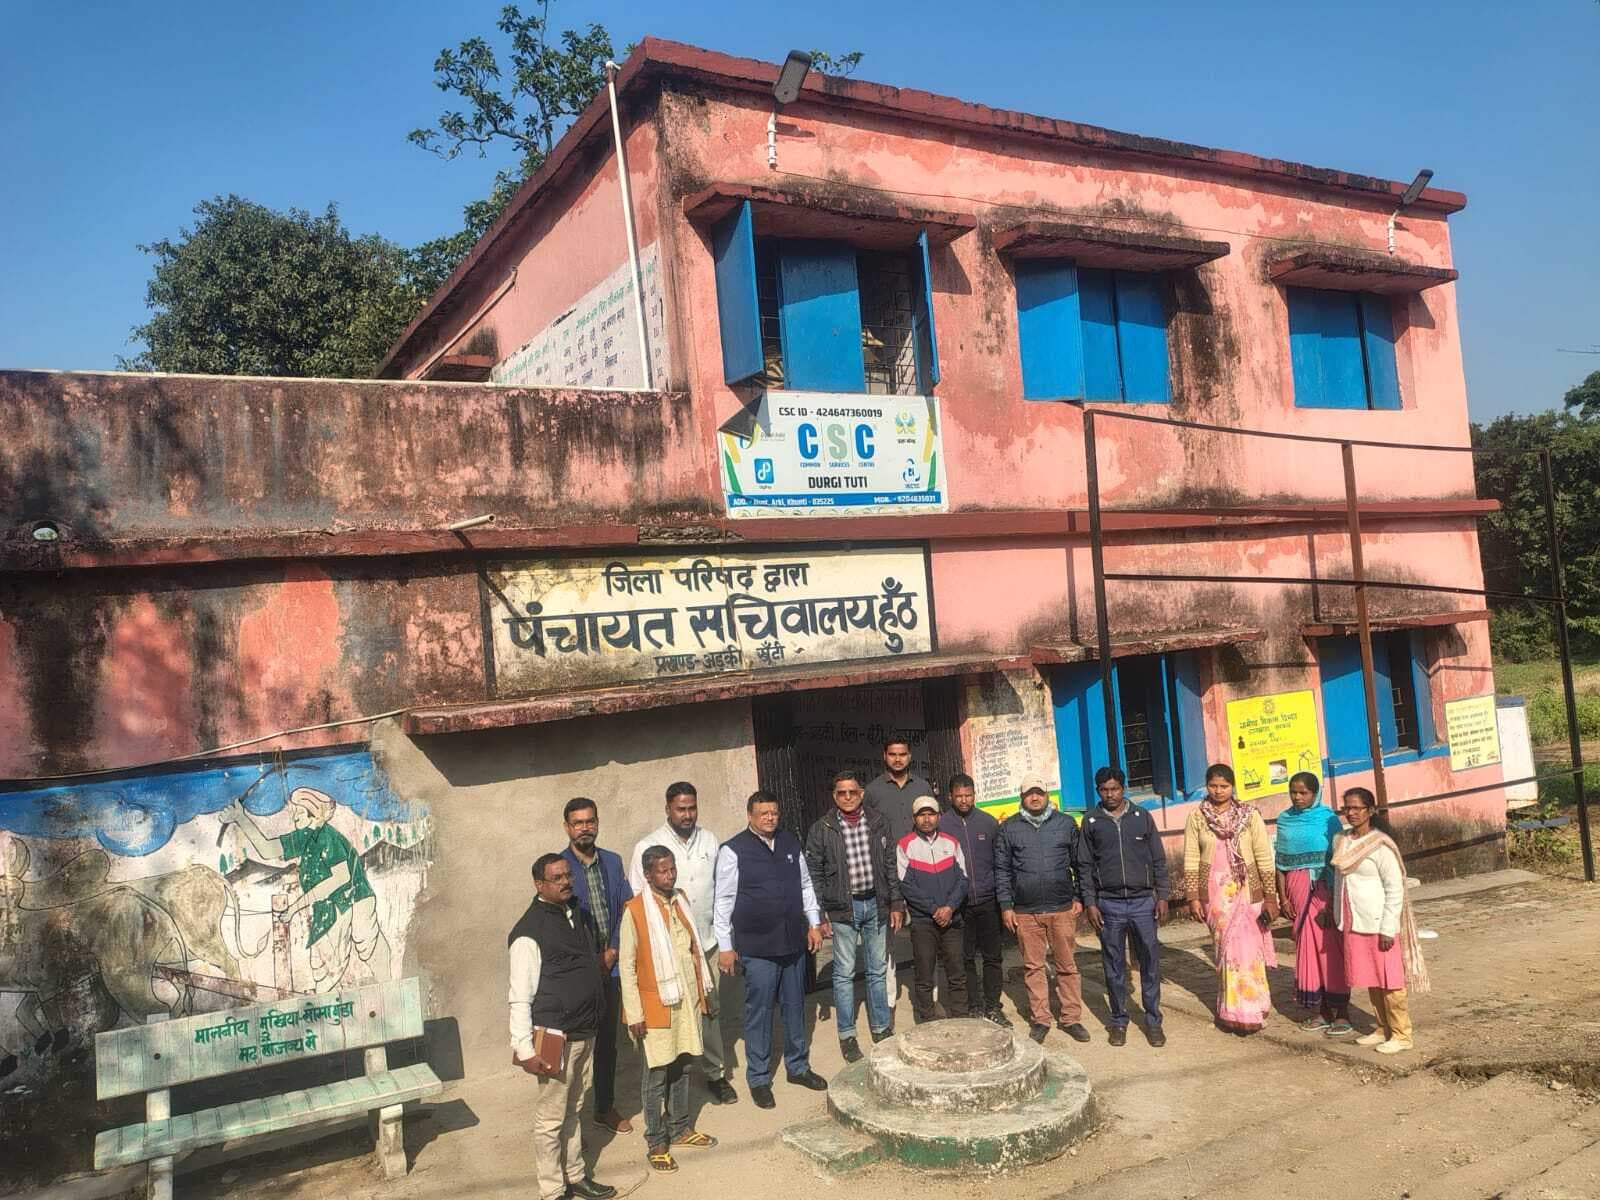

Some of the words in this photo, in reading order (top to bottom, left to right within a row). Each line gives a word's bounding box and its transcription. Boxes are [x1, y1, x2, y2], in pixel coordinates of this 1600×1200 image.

[779, 407, 795, 416] CSC
[798, 407, 808, 416] ID
[807, 476, 842, 489] DURGI
[843, 475, 868, 488] TUTI
[601, 561, 663, 597] जिला
[670, 559, 758, 592] परिषद
[763, 562, 810, 593] द्वारा
[502, 601, 678, 658] पंचायत
[686, 593, 879, 648] सचिवालय
